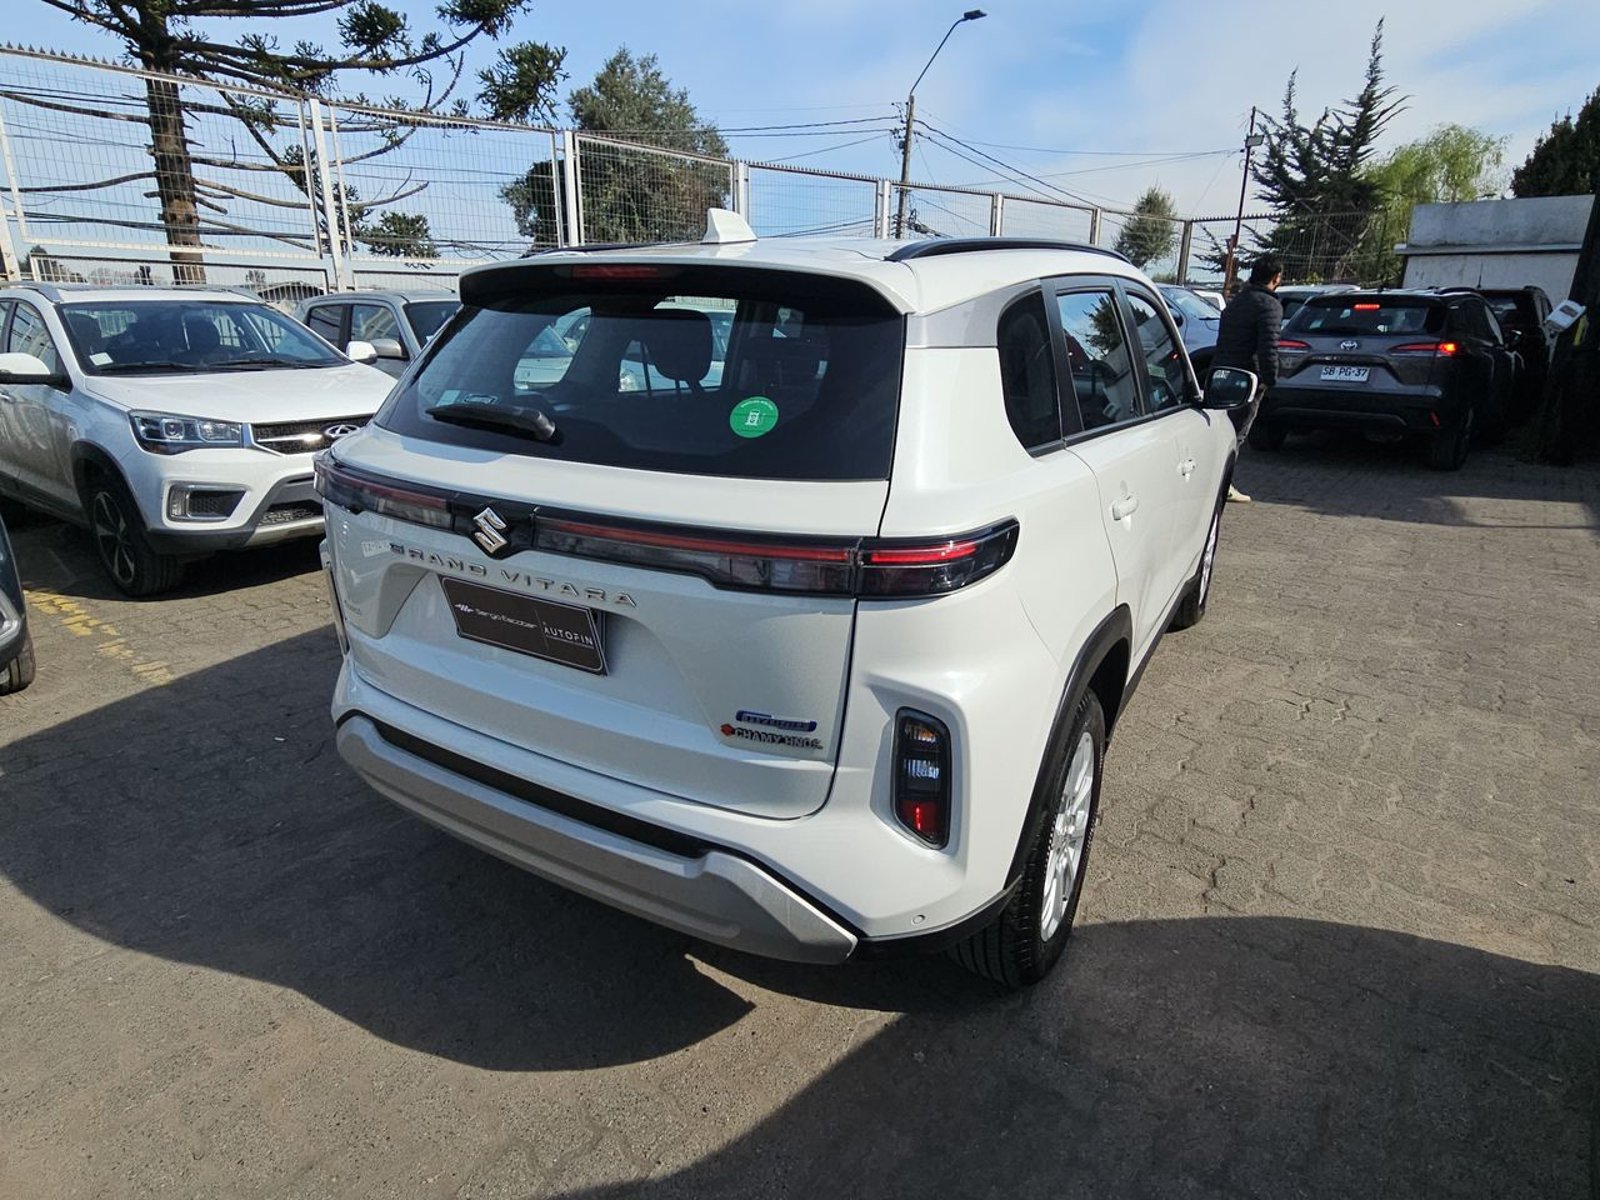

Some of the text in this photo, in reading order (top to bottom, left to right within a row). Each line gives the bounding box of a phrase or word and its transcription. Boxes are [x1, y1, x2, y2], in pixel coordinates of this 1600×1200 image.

[389, 542, 486, 577] GRAND
[500, 568, 638, 608] VITARA
[543, 626, 594, 646] AUTOFIN
